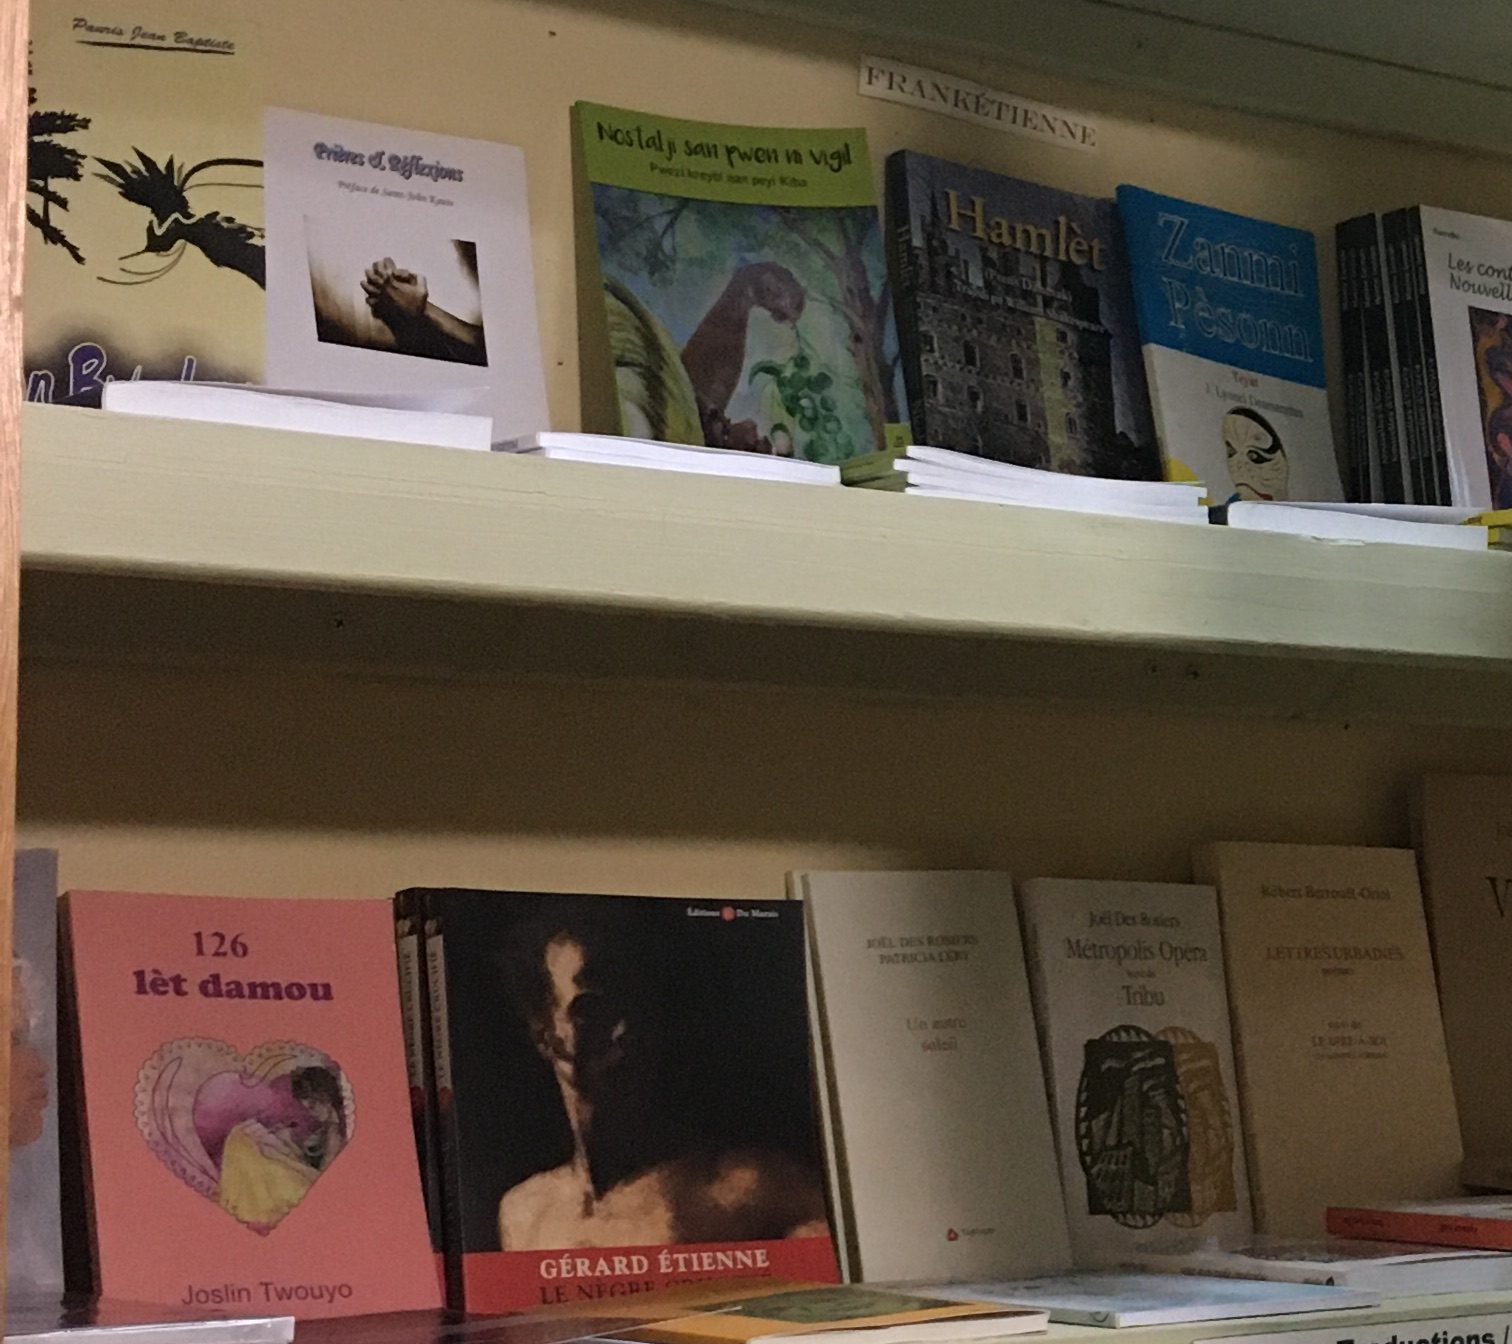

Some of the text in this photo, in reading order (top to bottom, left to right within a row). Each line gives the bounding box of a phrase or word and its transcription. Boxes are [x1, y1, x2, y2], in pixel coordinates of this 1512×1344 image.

[130, 26, 167, 41] Jean
[173, 31, 236, 50] Baptiste
[865, 65, 1098, 147] FRANKÉTIENNE
[684, 139, 719, 159] san
[725, 143, 780, 168] pwen
[945, 188, 1108, 270] Hamlèt
[1157, 212, 1302, 298] Zanmi
[1447, 252, 1472, 274] Les
[1162, 277, 1314, 363] Pèsonn
[193, 931, 249, 959] 126
[133, 969, 334, 1002] lèt damou
[540, 1249, 770, 1279] GÉRARD ÉTIENNE
[181, 1281, 353, 1307] Joslin Twouyo
[540, 1285, 569, 1305] LE
